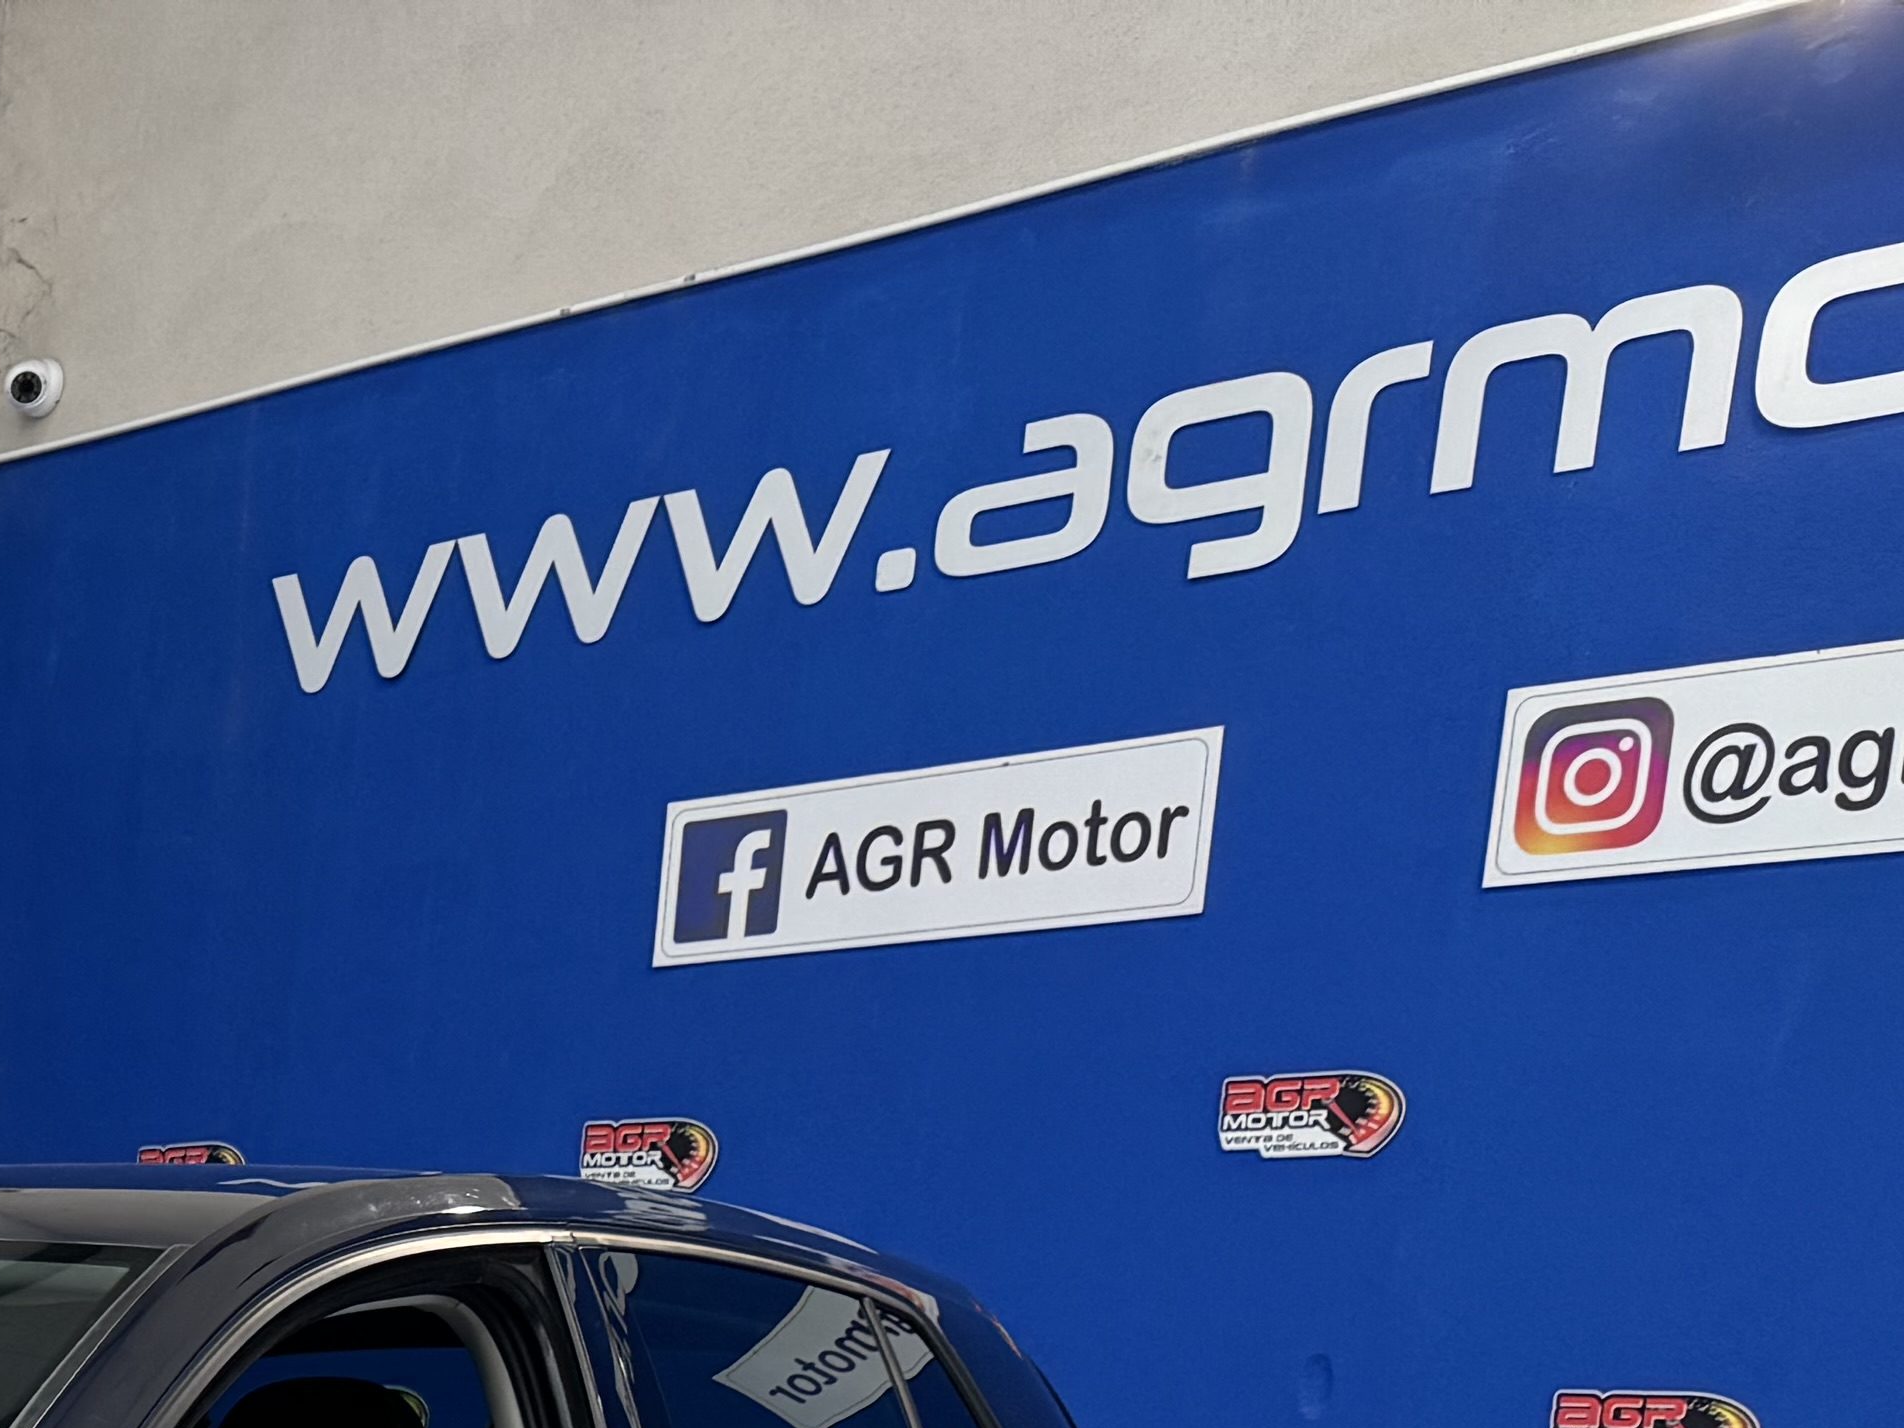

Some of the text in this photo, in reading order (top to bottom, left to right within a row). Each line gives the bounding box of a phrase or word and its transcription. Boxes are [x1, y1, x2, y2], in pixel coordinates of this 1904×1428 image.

[1682, 722, 1904, 825] @ag
[804, 799, 1191, 900] AGR Motor
[1222, 1110, 1332, 1132] MOTOR
[583, 1151, 664, 1170] MOTOR
